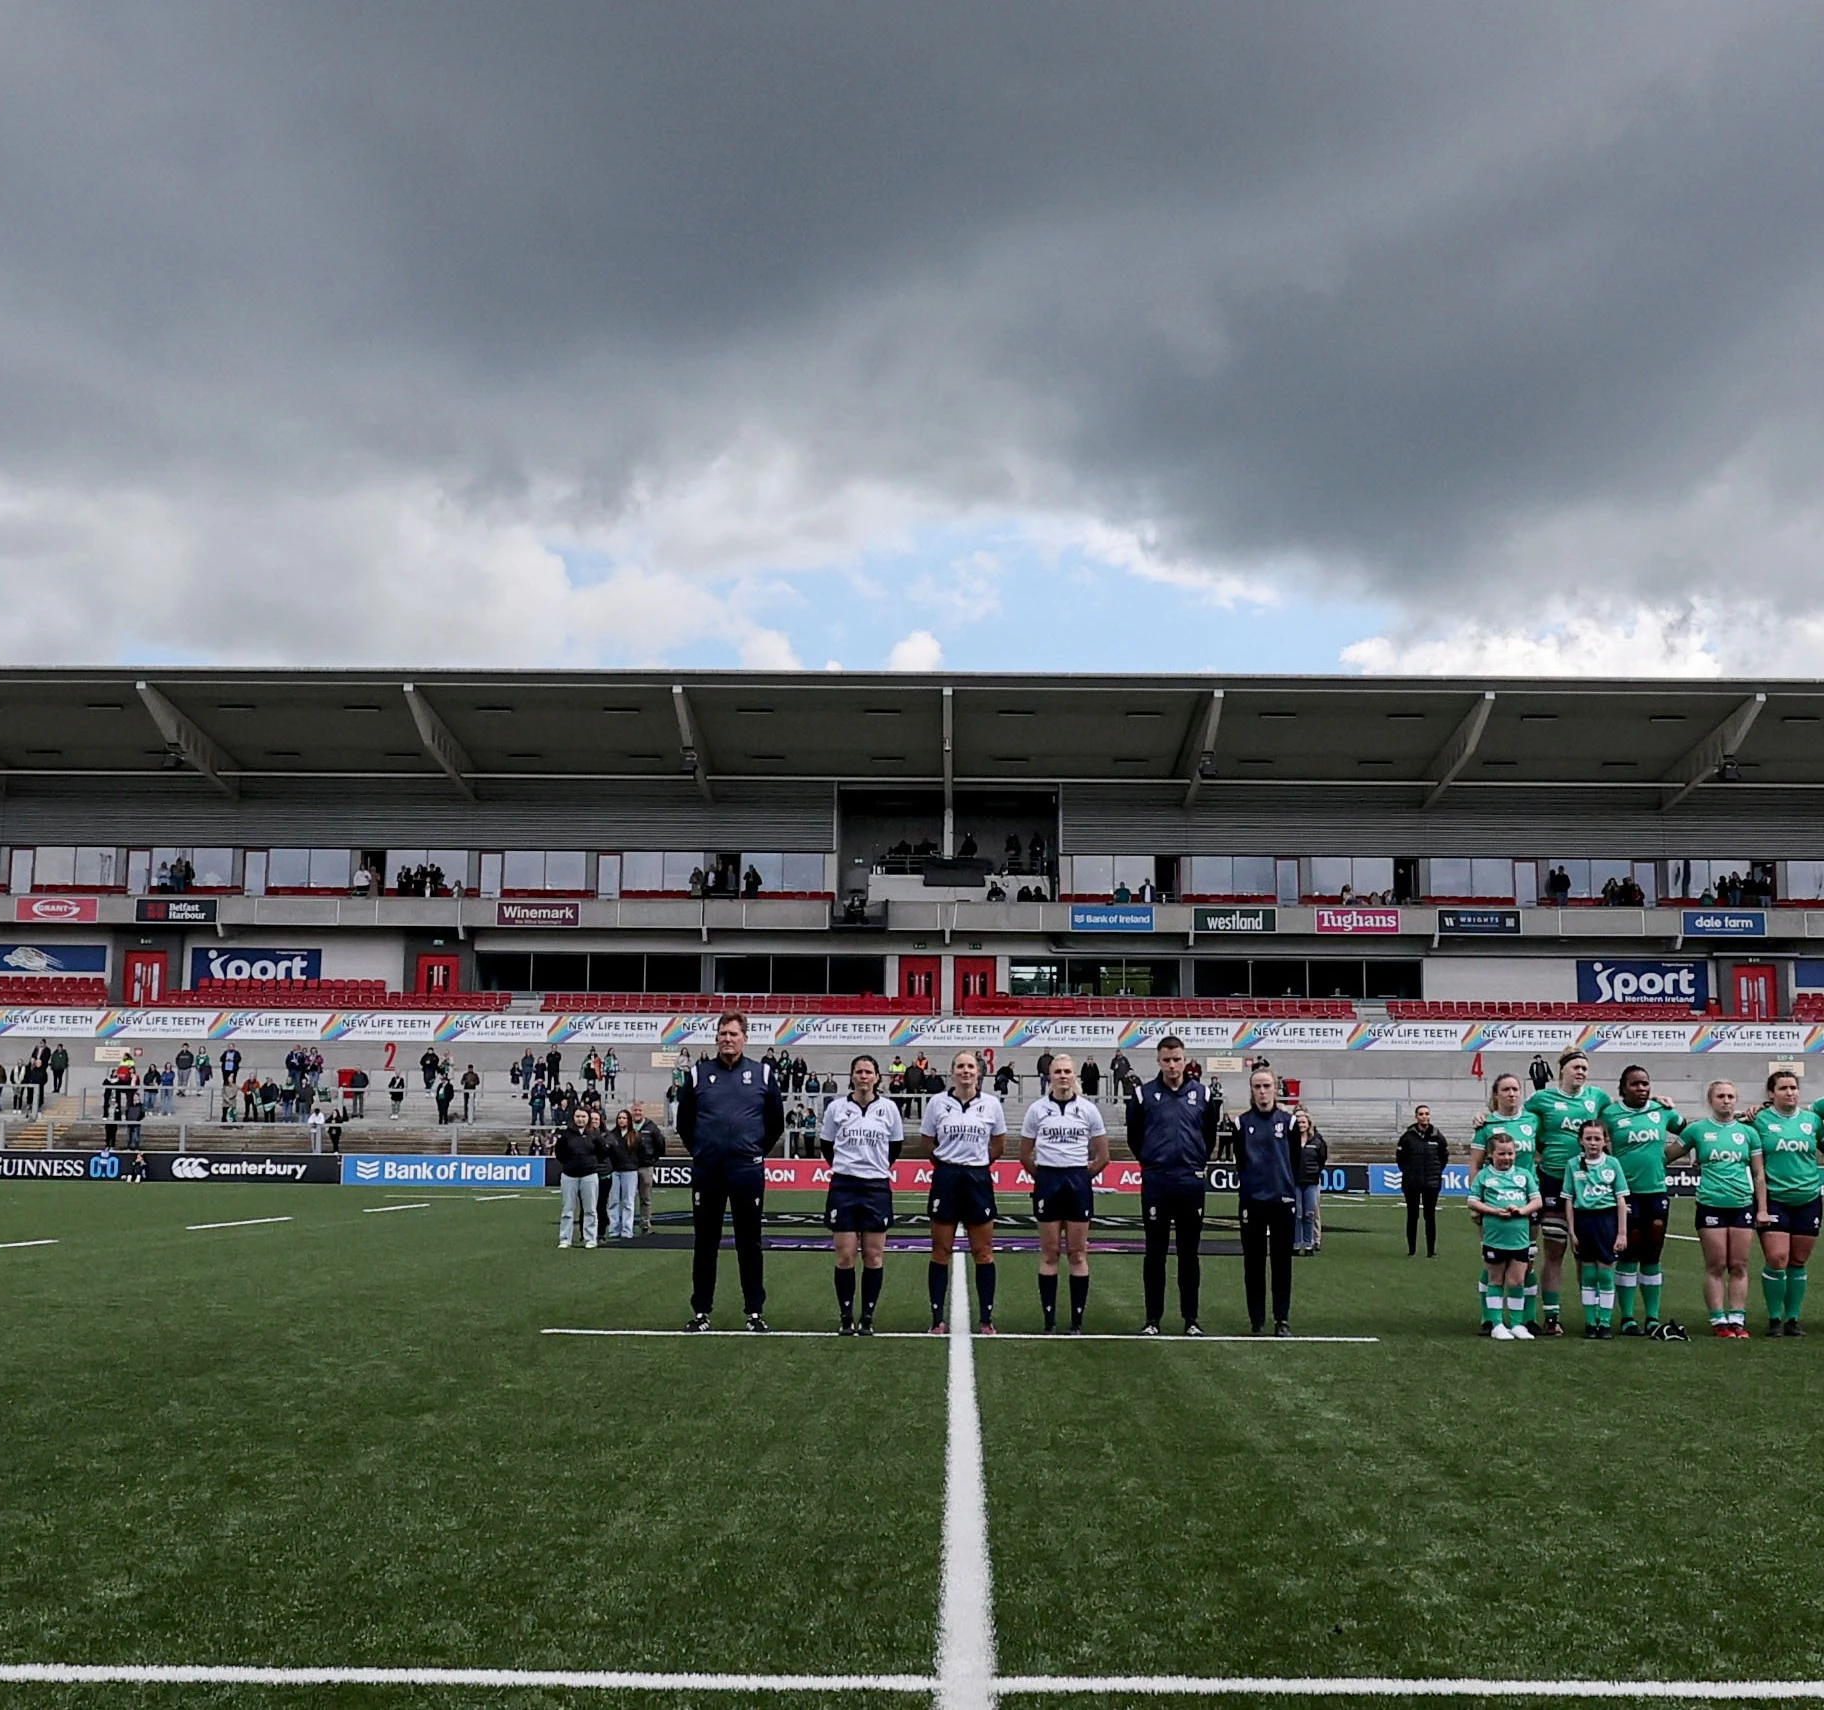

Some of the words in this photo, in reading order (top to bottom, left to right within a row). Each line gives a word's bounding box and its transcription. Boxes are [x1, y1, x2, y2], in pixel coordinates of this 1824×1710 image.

[169, 903, 200, 912] Belfast
[503, 906, 573, 918] Winemark
[168, 911, 206, 920] Harbour
[1086, 914, 1107, 924] Bank
[1108, 914, 1118, 924] of
[1119, 914, 1150, 924] Ireland
[1207, 912, 1263, 930] westland
[1319, 911, 1397, 931] Tughans
[1695, 916, 1722, 928] dale
[1724, 916, 1753, 928] farm
[1593, 962, 1696, 1003] Sport
[4, 1015, 31, 1023] NEW
[33, 1015, 56, 1024] LIFE
[60, 1015, 93, 1024] TEETH
[116, 1017, 143, 1025] NEW
[145, 1017, 168, 1026] LIFE
[172, 1017, 205, 1026] TEETH
[228, 1018, 255, 1026] NEW
[258, 1018, 281, 1027] LIFE
[284, 1018, 318, 1027] TEETH
[341, 1019, 368, 1027] NEW
[371, 1019, 394, 1028] LIFE
[397, 1019, 431, 1028] TEETH
[454, 1020, 481, 1028] NEW
[484, 1020, 507, 1029] LIFE
[510, 1020, 544, 1029] TEETH
[568, 1021, 595, 1030] NEW
[598, 1021, 621, 1031] LIFE
[624, 1021, 658, 1031] TEETH
[795, 1023, 823, 1032] NEW
[825, 1023, 849, 1033] LIFE
[852, 1023, 887, 1033] TEETH
[910, 1024, 938, 1033] NEW
[940, 1024, 963, 1034] LIFE
[967, 1024, 1001, 1034] TEETH
[1024, 1025, 1052, 1034] NEW
[1054, 1025, 1077, 1035] LIFE
[1081, 1025, 1115, 1035] TEETH
[1138, 1027, 1166, 1035] NEW
[1168, 1027, 1191, 1036] LIFE
[1195, 1027, 1229, 1036] TEETH
[1252, 1027, 1280, 1036] NEW
[1282, 1027, 1305, 1037] LIFE
[1309, 1027, 1343, 1037] TEETH
[1367, 1028, 1394, 1037] NEW
[1397, 1028, 1420, 1038] LIFE
[1423, 1028, 1457, 1038] TEETH
[1481, 1029, 1509, 1038] NEW
[1511, 1029, 1534, 1039] LIFE
[1538, 1029, 1572, 1039] TEETH
[1596, 1030, 1623, 1038] NEW
[1626, 1030, 1649, 1039] LIFE
[1652, 1030, 1686, 1039] TEETH
[1710, 1031, 1737, 1039] NEW
[1740, 1031, 1763, 1040] LIFE
[1766, 1031, 1800, 1040] TEETH
[384, 1042, 396, 1071] 2
[983, 1048, 994, 1074] 3
[1472, 1053, 1483, 1081] 4
[842, 1128, 885, 1141] Emirates
[943, 1124, 986, 1136] Emirates
[1042, 1126, 1085, 1136] Emirates
[1628, 1129, 1659, 1143] AON
[1776, 1139, 1810, 1152] AON
[1710, 1150, 1741, 1162] AON
[211, 1158, 307, 1180] canterbury
[385, 1162, 432, 1179] Bank
[436, 1162, 459, 1180] of
[462, 1162, 530, 1181] Ireland
[1583, 1184, 1612, 1198] AON
